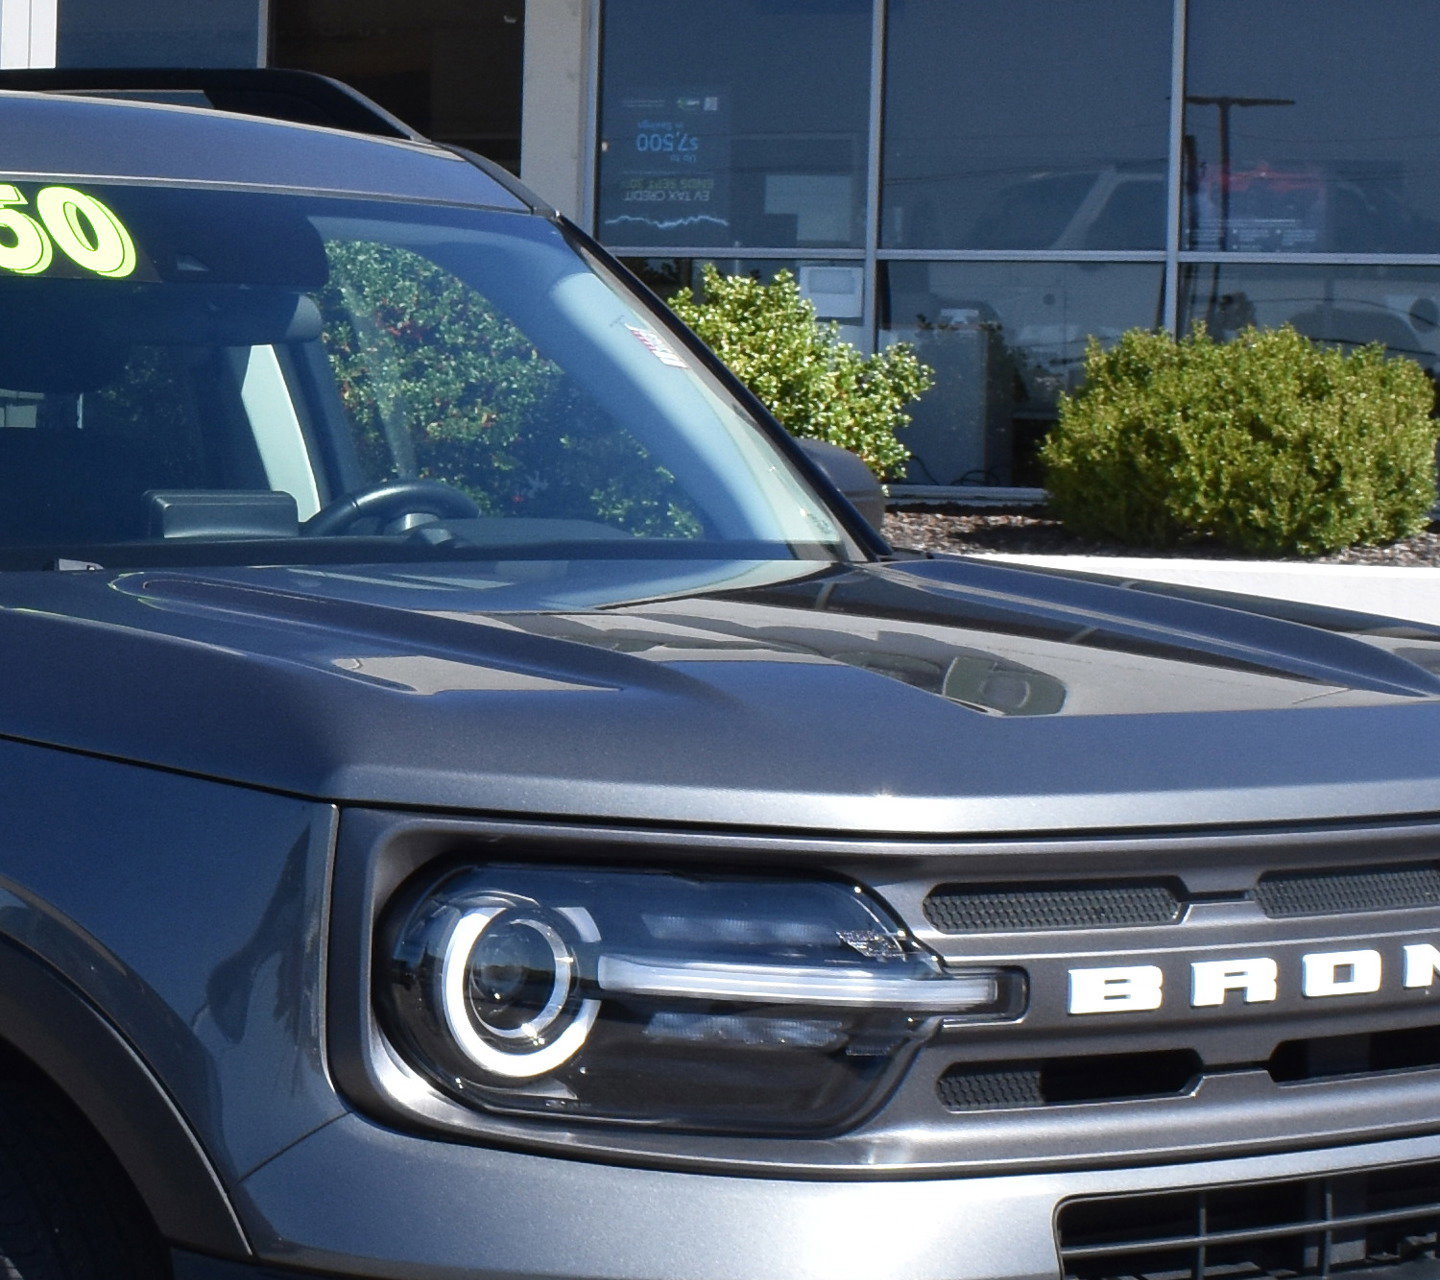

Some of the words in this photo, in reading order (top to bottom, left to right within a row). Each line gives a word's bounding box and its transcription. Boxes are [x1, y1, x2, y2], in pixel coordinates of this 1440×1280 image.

[636, 131, 698, 152] $7,500
[623, 190, 666, 202] CREDIT
[668, 190, 691, 202] TAX
[694, 190, 710, 202] EV
